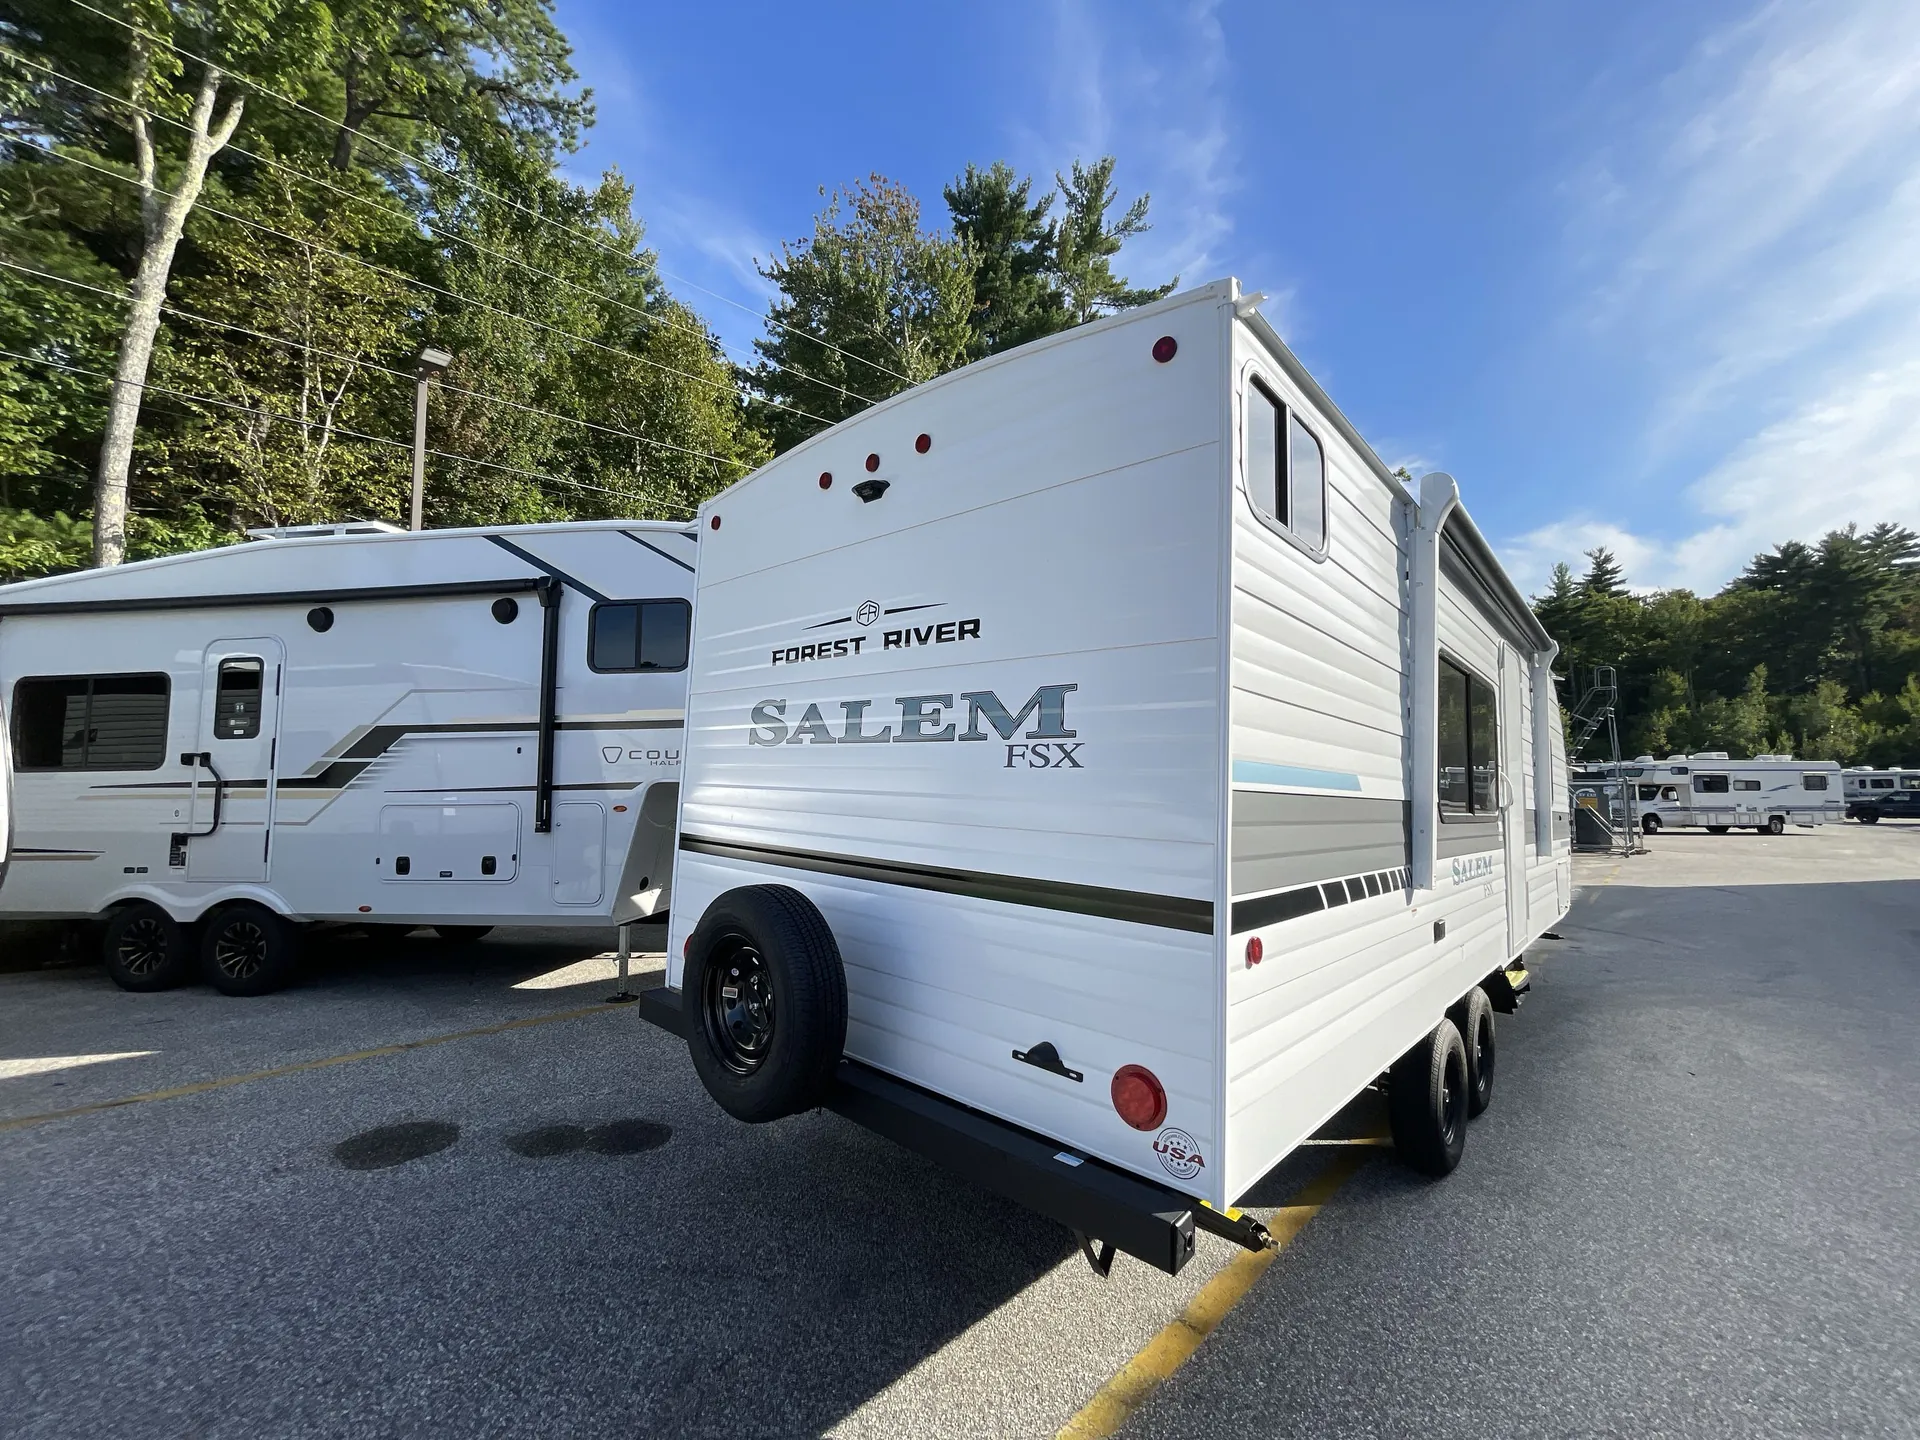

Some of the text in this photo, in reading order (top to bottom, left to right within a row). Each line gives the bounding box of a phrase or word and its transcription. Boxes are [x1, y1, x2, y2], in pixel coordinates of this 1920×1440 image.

[771, 618, 981, 666] FOREST RIVER
[748, 683, 1078, 747] SALEM
[629, 750, 680, 760] COU
[1003, 742, 1086, 769] FSX
[1452, 854, 1493, 886] SALEM
[1152, 1140, 1206, 1169] USA
